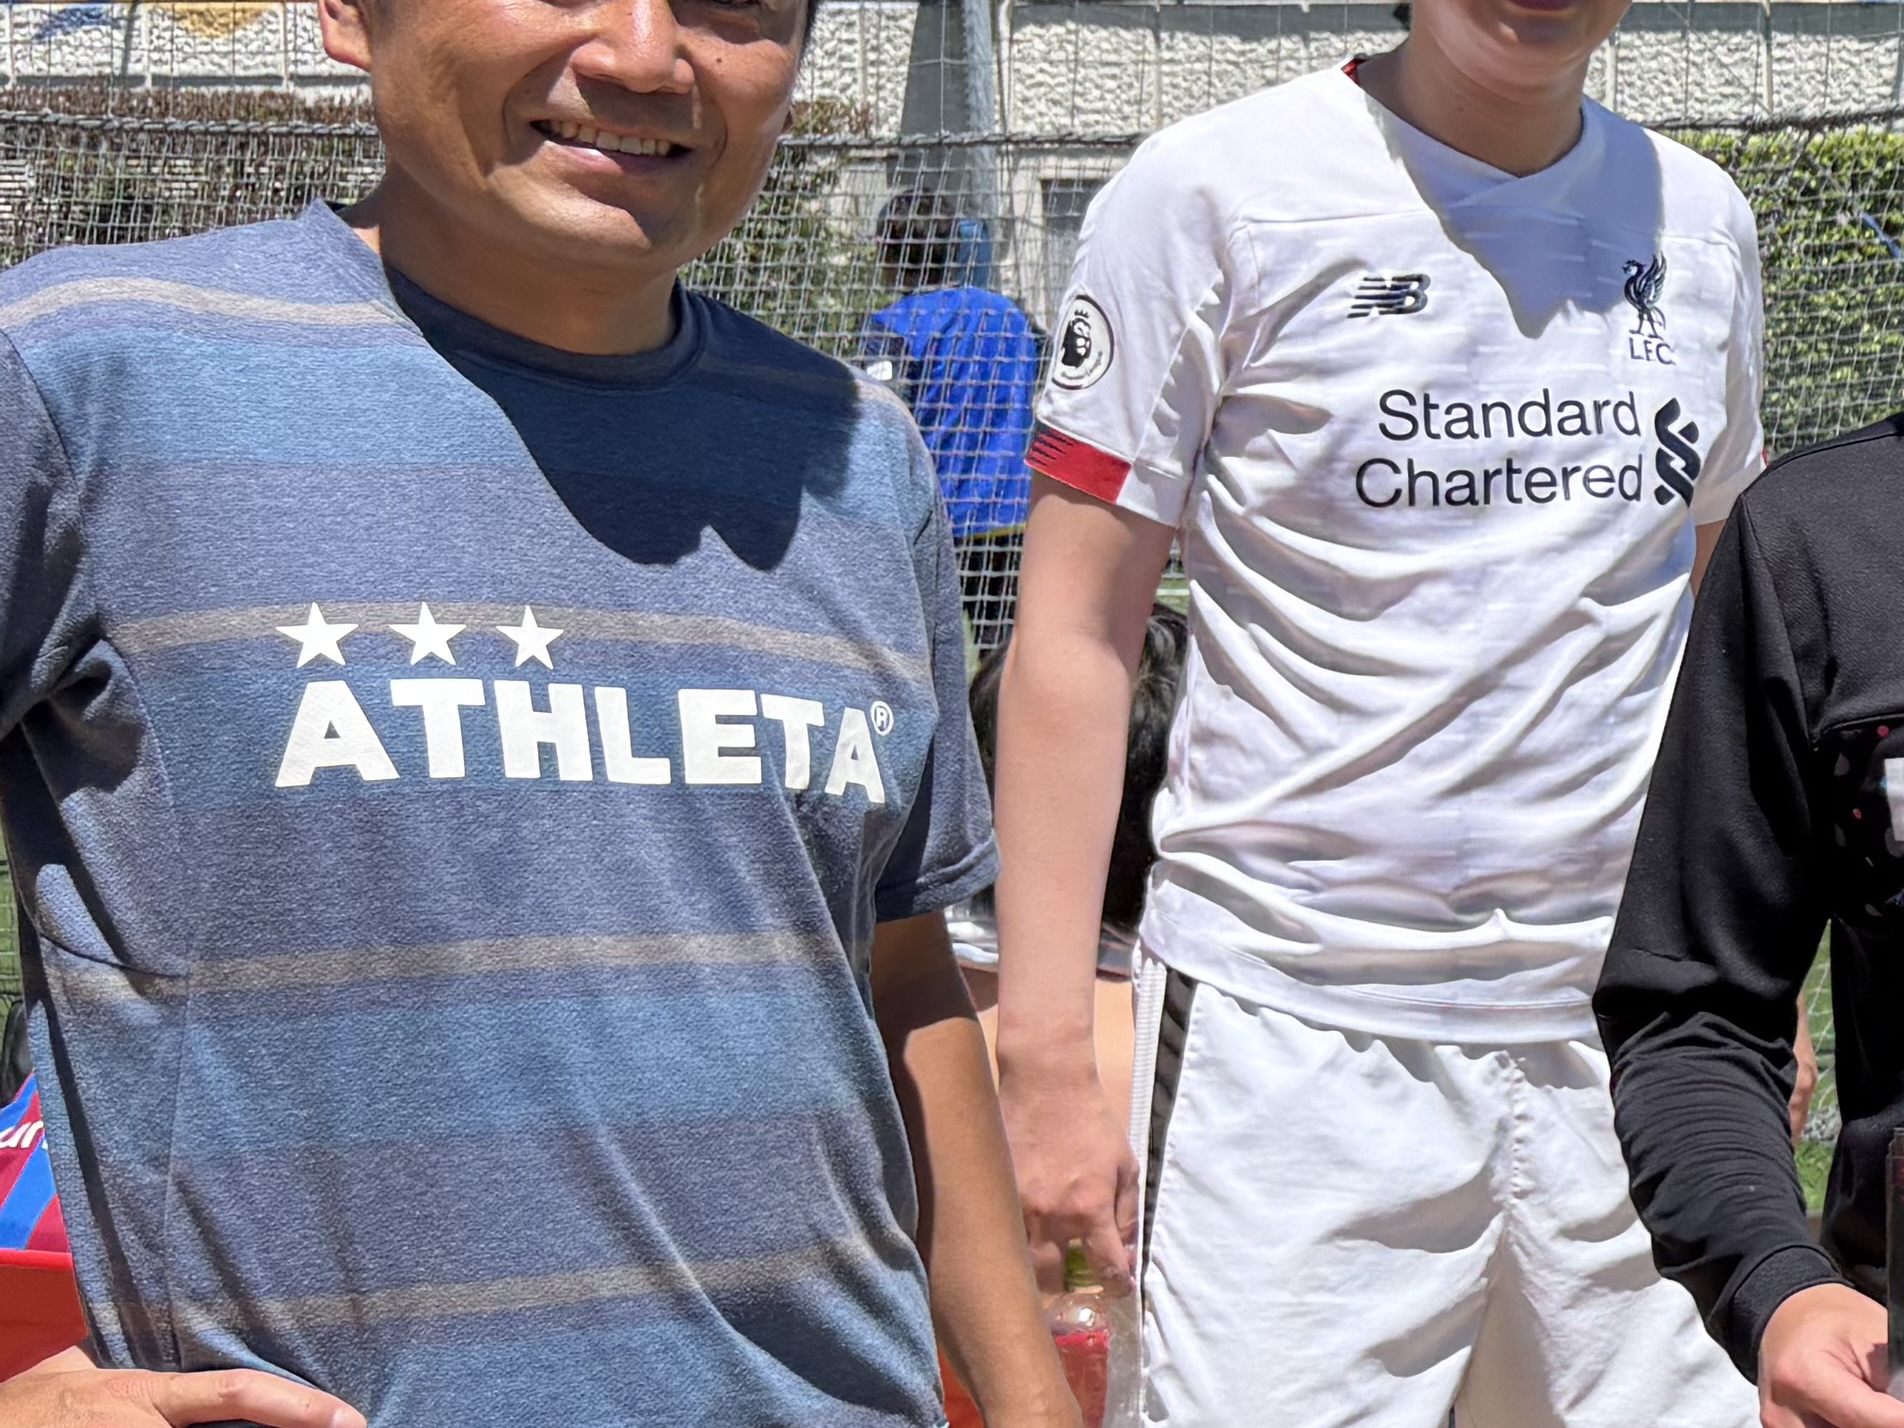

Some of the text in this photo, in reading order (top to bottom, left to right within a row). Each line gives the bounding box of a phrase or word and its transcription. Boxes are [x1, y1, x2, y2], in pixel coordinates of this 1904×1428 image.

[1628, 337, 1677, 365] LFC
[1378, 389, 1641, 441] Standard
[1355, 455, 1643, 509] Chartered
